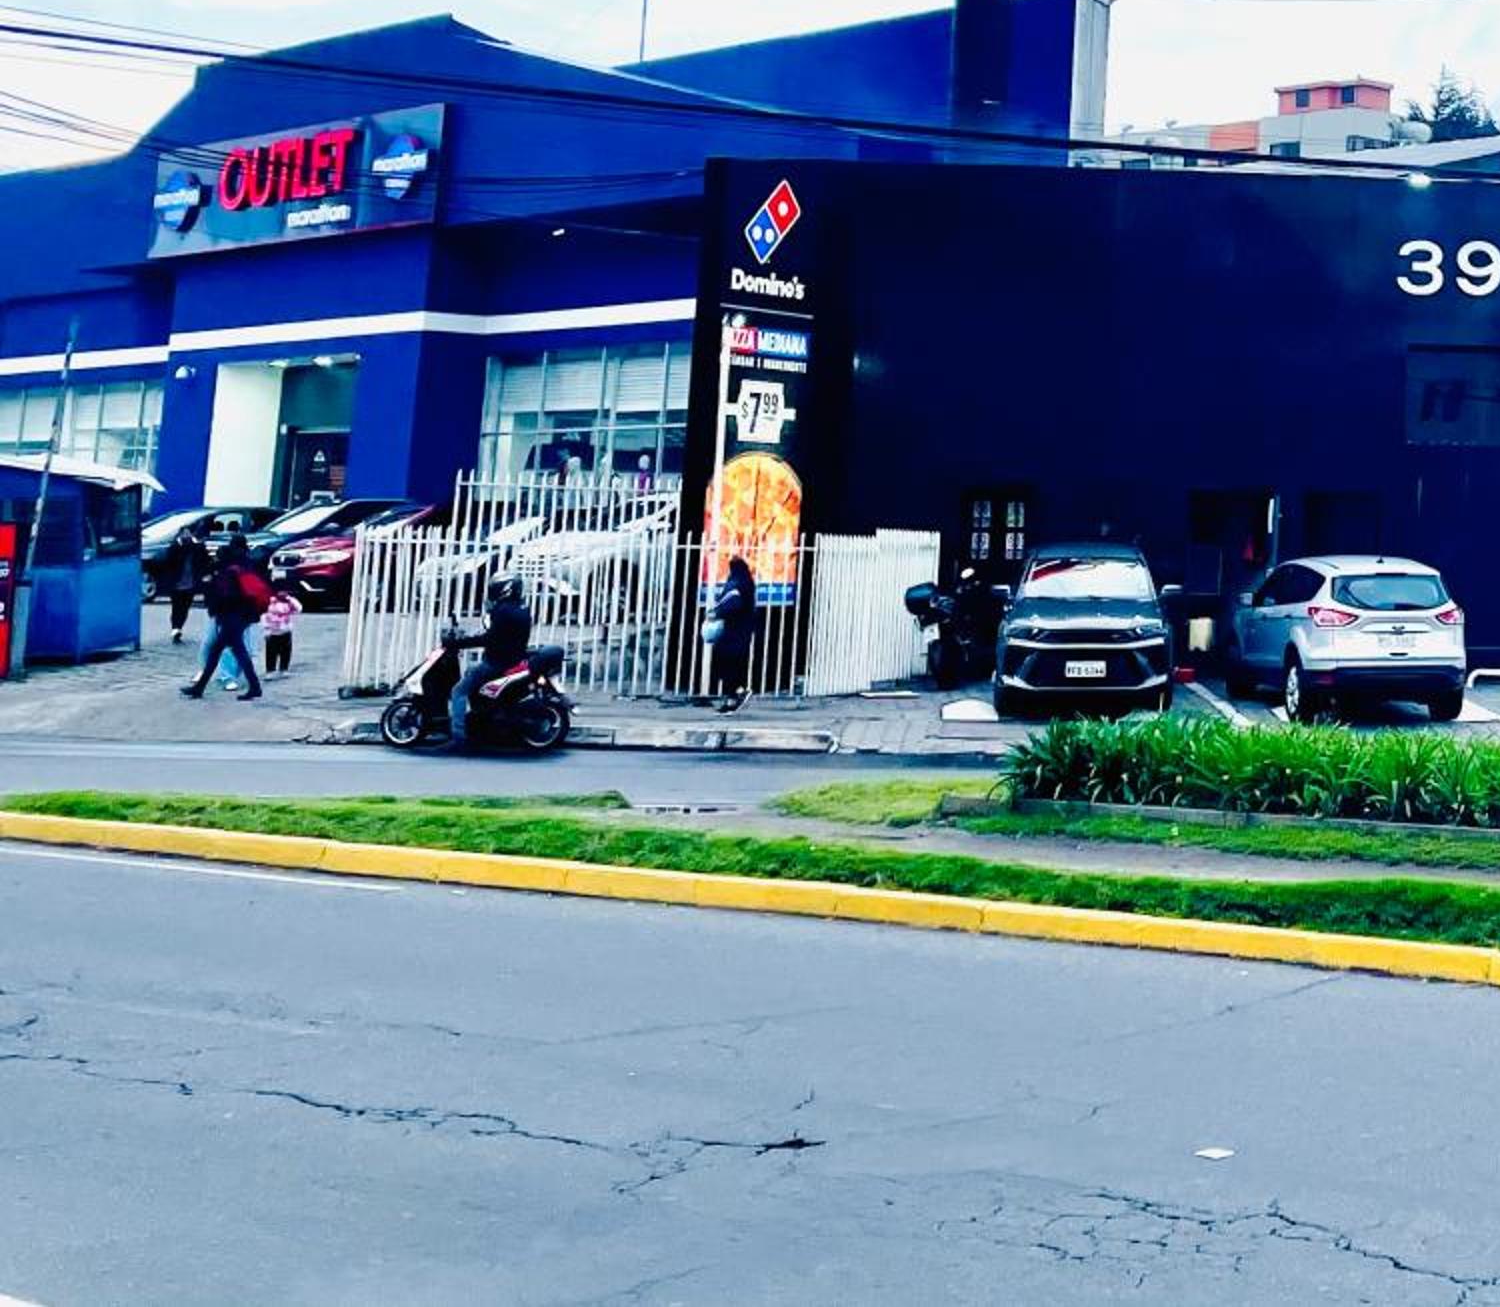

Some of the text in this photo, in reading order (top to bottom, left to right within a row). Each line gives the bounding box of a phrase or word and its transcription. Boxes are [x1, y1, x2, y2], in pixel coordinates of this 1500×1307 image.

[218, 127, 354, 211] OUTLET
[730, 267, 806, 301] Domino's
[757, 330, 807, 356] MEDIANA
